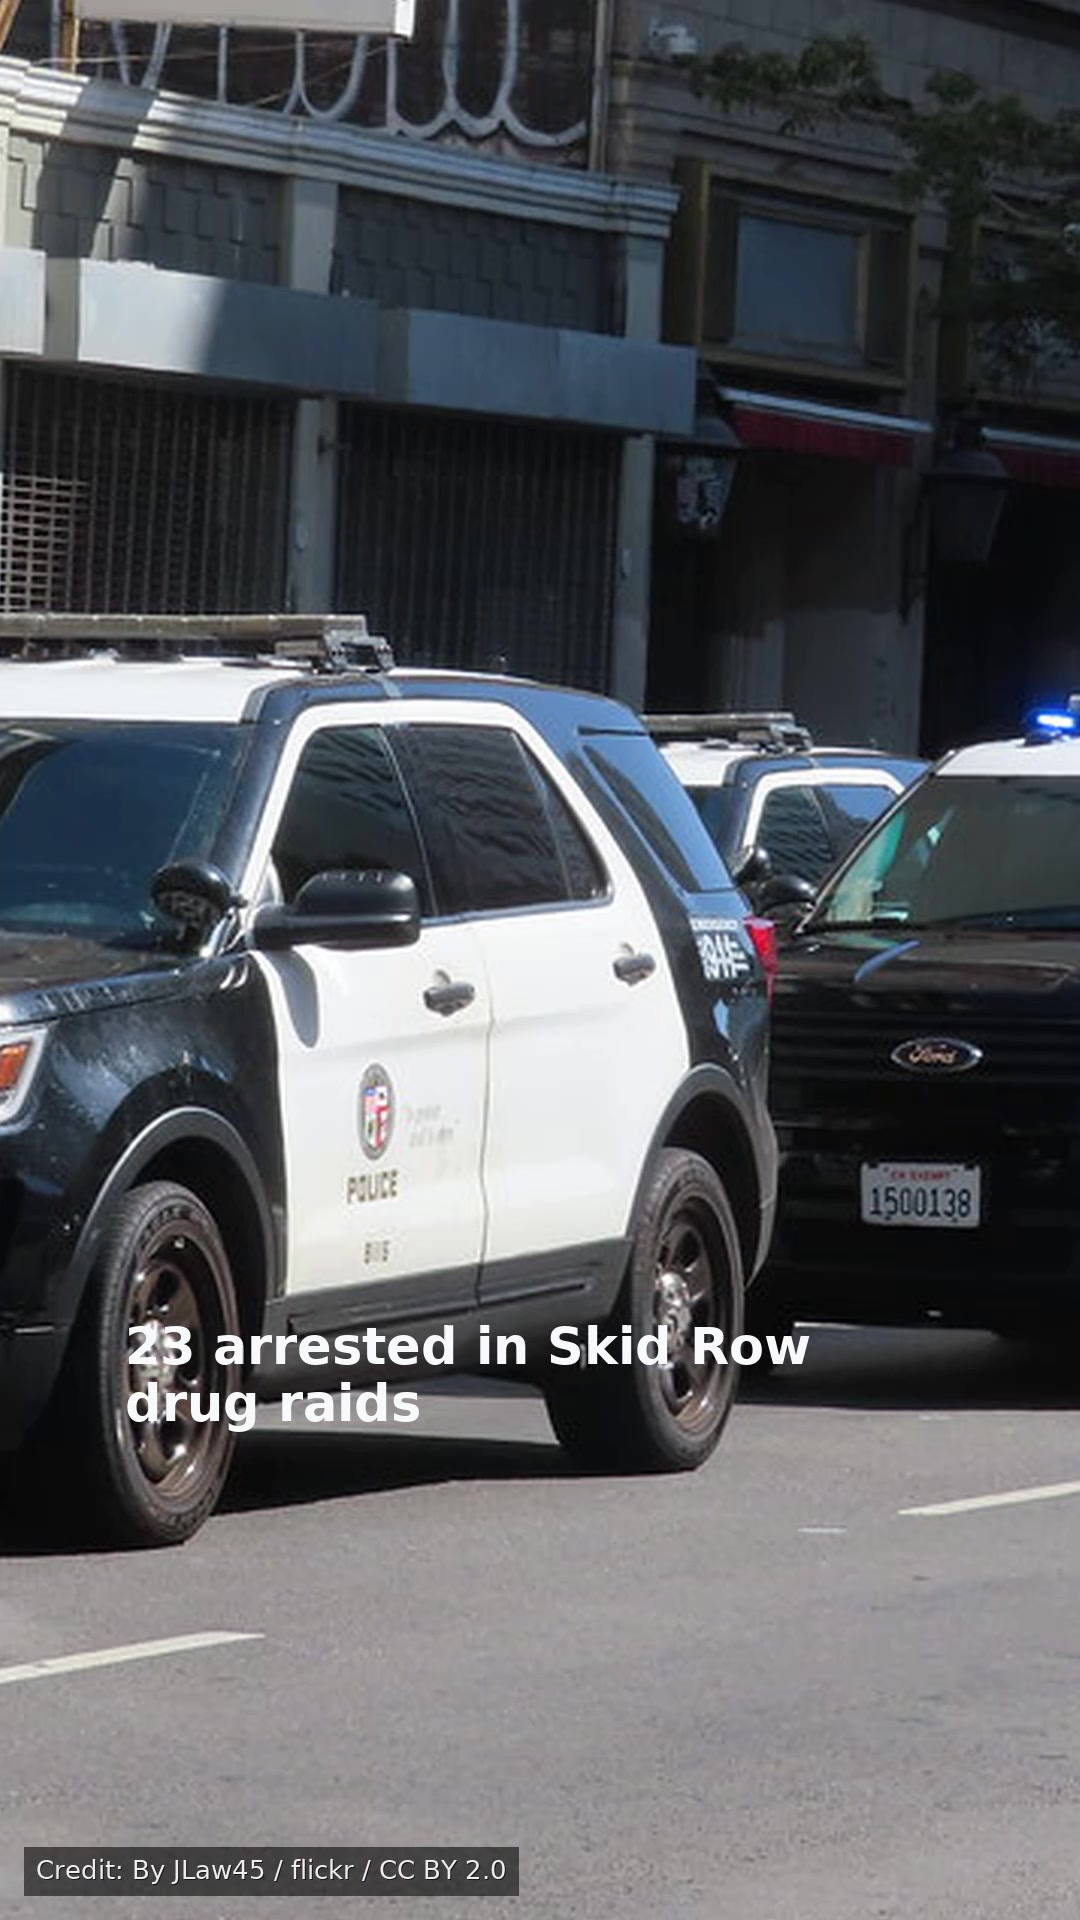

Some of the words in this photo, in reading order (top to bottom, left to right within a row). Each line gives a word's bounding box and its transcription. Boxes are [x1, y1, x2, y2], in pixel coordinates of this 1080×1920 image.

[908, 1043, 958, 1064] Ford
[346, 1168, 398, 1205] POLICE
[869, 1186, 972, 1218] 1500138
